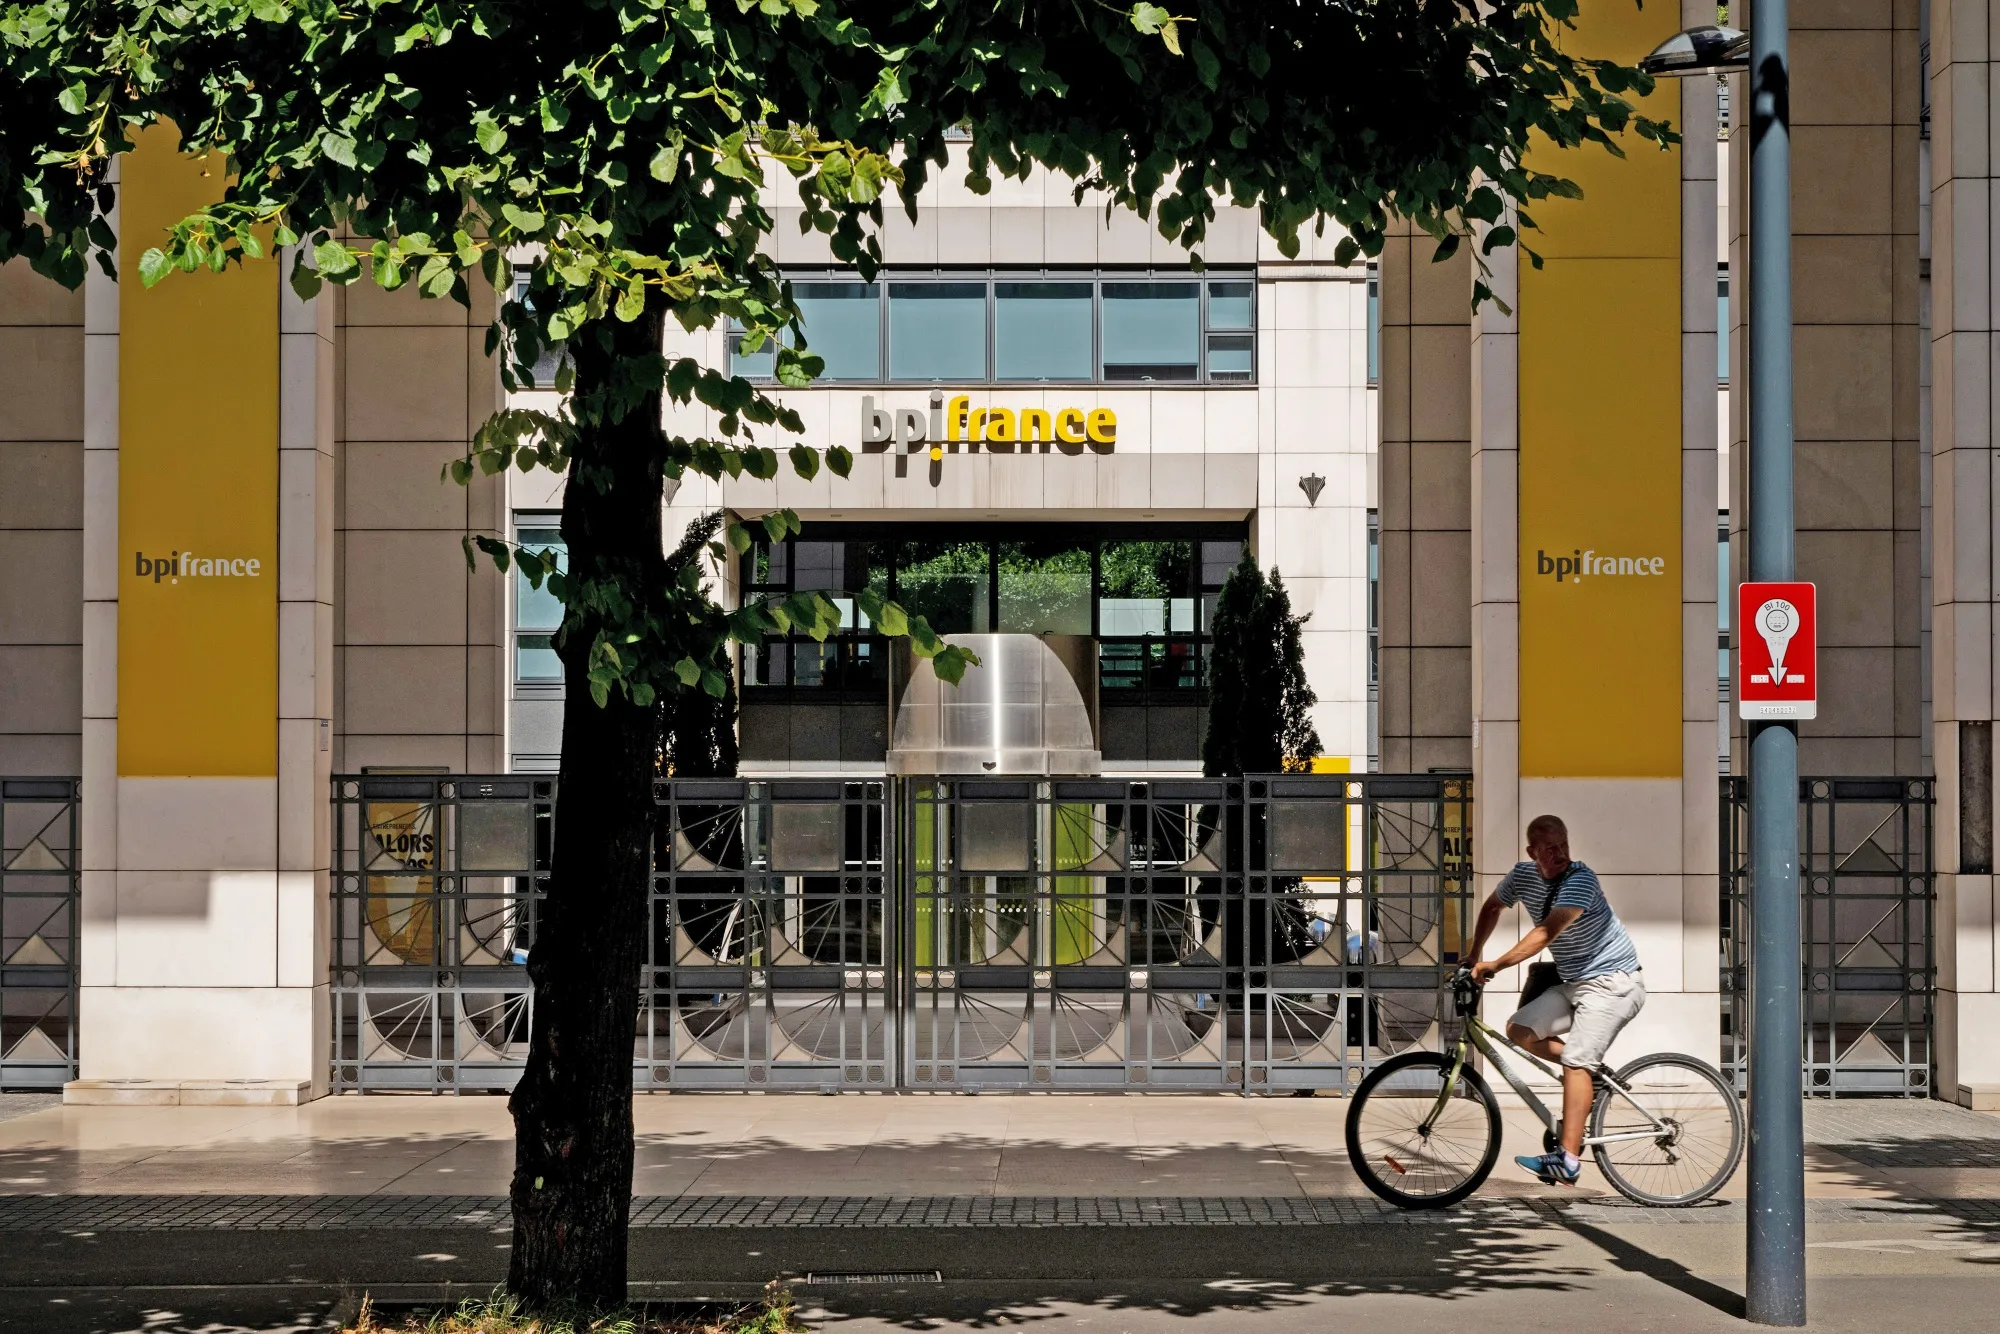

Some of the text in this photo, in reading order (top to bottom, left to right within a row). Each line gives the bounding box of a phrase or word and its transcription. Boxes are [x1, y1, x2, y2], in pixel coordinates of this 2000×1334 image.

[862, 389, 1117, 461] bpifrance
[136, 551, 261, 584] bpifrance
[1537, 549, 1665, 583] bpifrance
[1775, 601, 1790, 611] 100
[375, 833, 434, 853] ALORS
[1443, 837, 1473, 857] ALO
